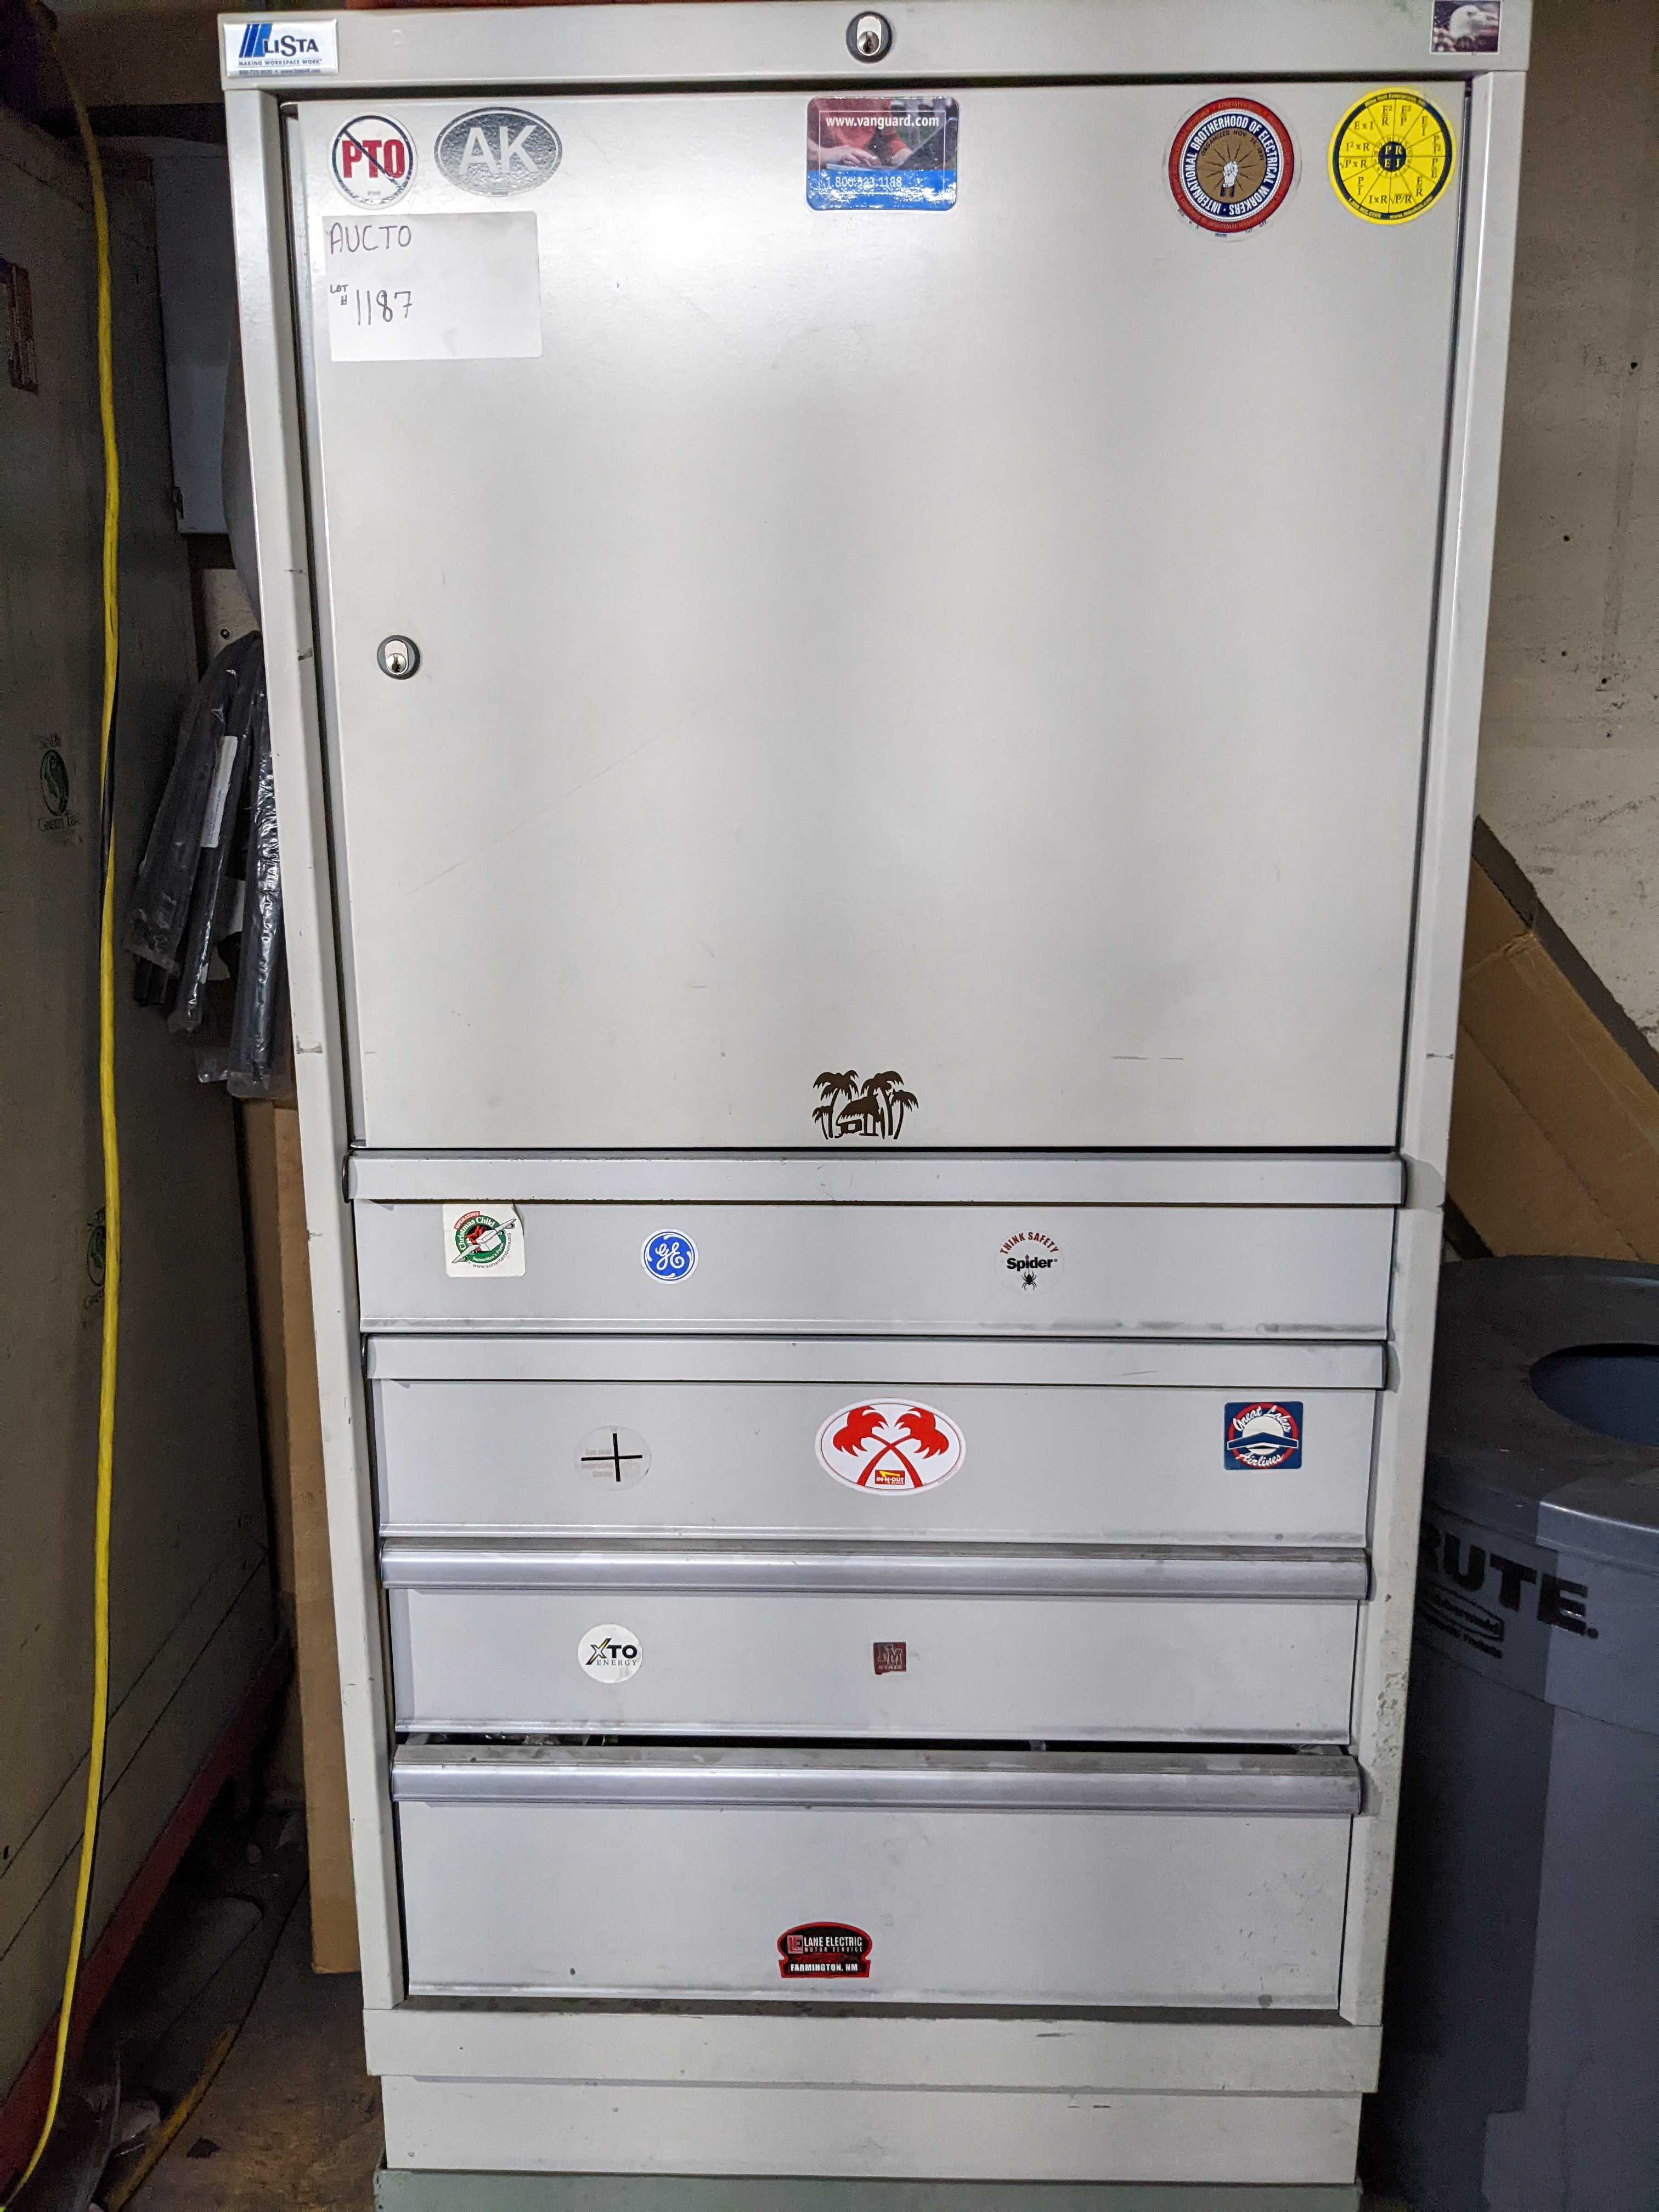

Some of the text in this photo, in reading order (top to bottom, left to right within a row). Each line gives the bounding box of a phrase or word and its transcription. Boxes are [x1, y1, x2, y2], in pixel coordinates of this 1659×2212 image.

[826, 114, 939, 129] www.vanguard.com
[1190, 116, 1249, 150] BROTHERHOOD
[1249, 119, 1262, 134] OF
[342, 139, 405, 178] PTO
[459, 125, 542, 175] AK
[1258, 131, 1278, 185] ELECTRICAL
[1185, 153, 1221, 215] INTERNATIONAL
[1229, 185, 1272, 216] WORKERS
[330, 222, 411, 255] AUCTO
[330, 284, 349, 294] LOT
[356, 290, 413, 325] 1187
[456, 1212, 479, 1229] OPERATION
[459, 1217, 495, 1250] Christmas Child
[1000, 1232, 1059, 1254] THINK SAFETY
[1007, 1256, 1053, 1271] Spider
[1232, 1405, 1291, 1433] Great Lakes
[1235, 1452, 1284, 1466] Airlines
[585, 1638, 638, 1665] XTO
[804, 1936, 862, 1946] LANE ELECTRIC
